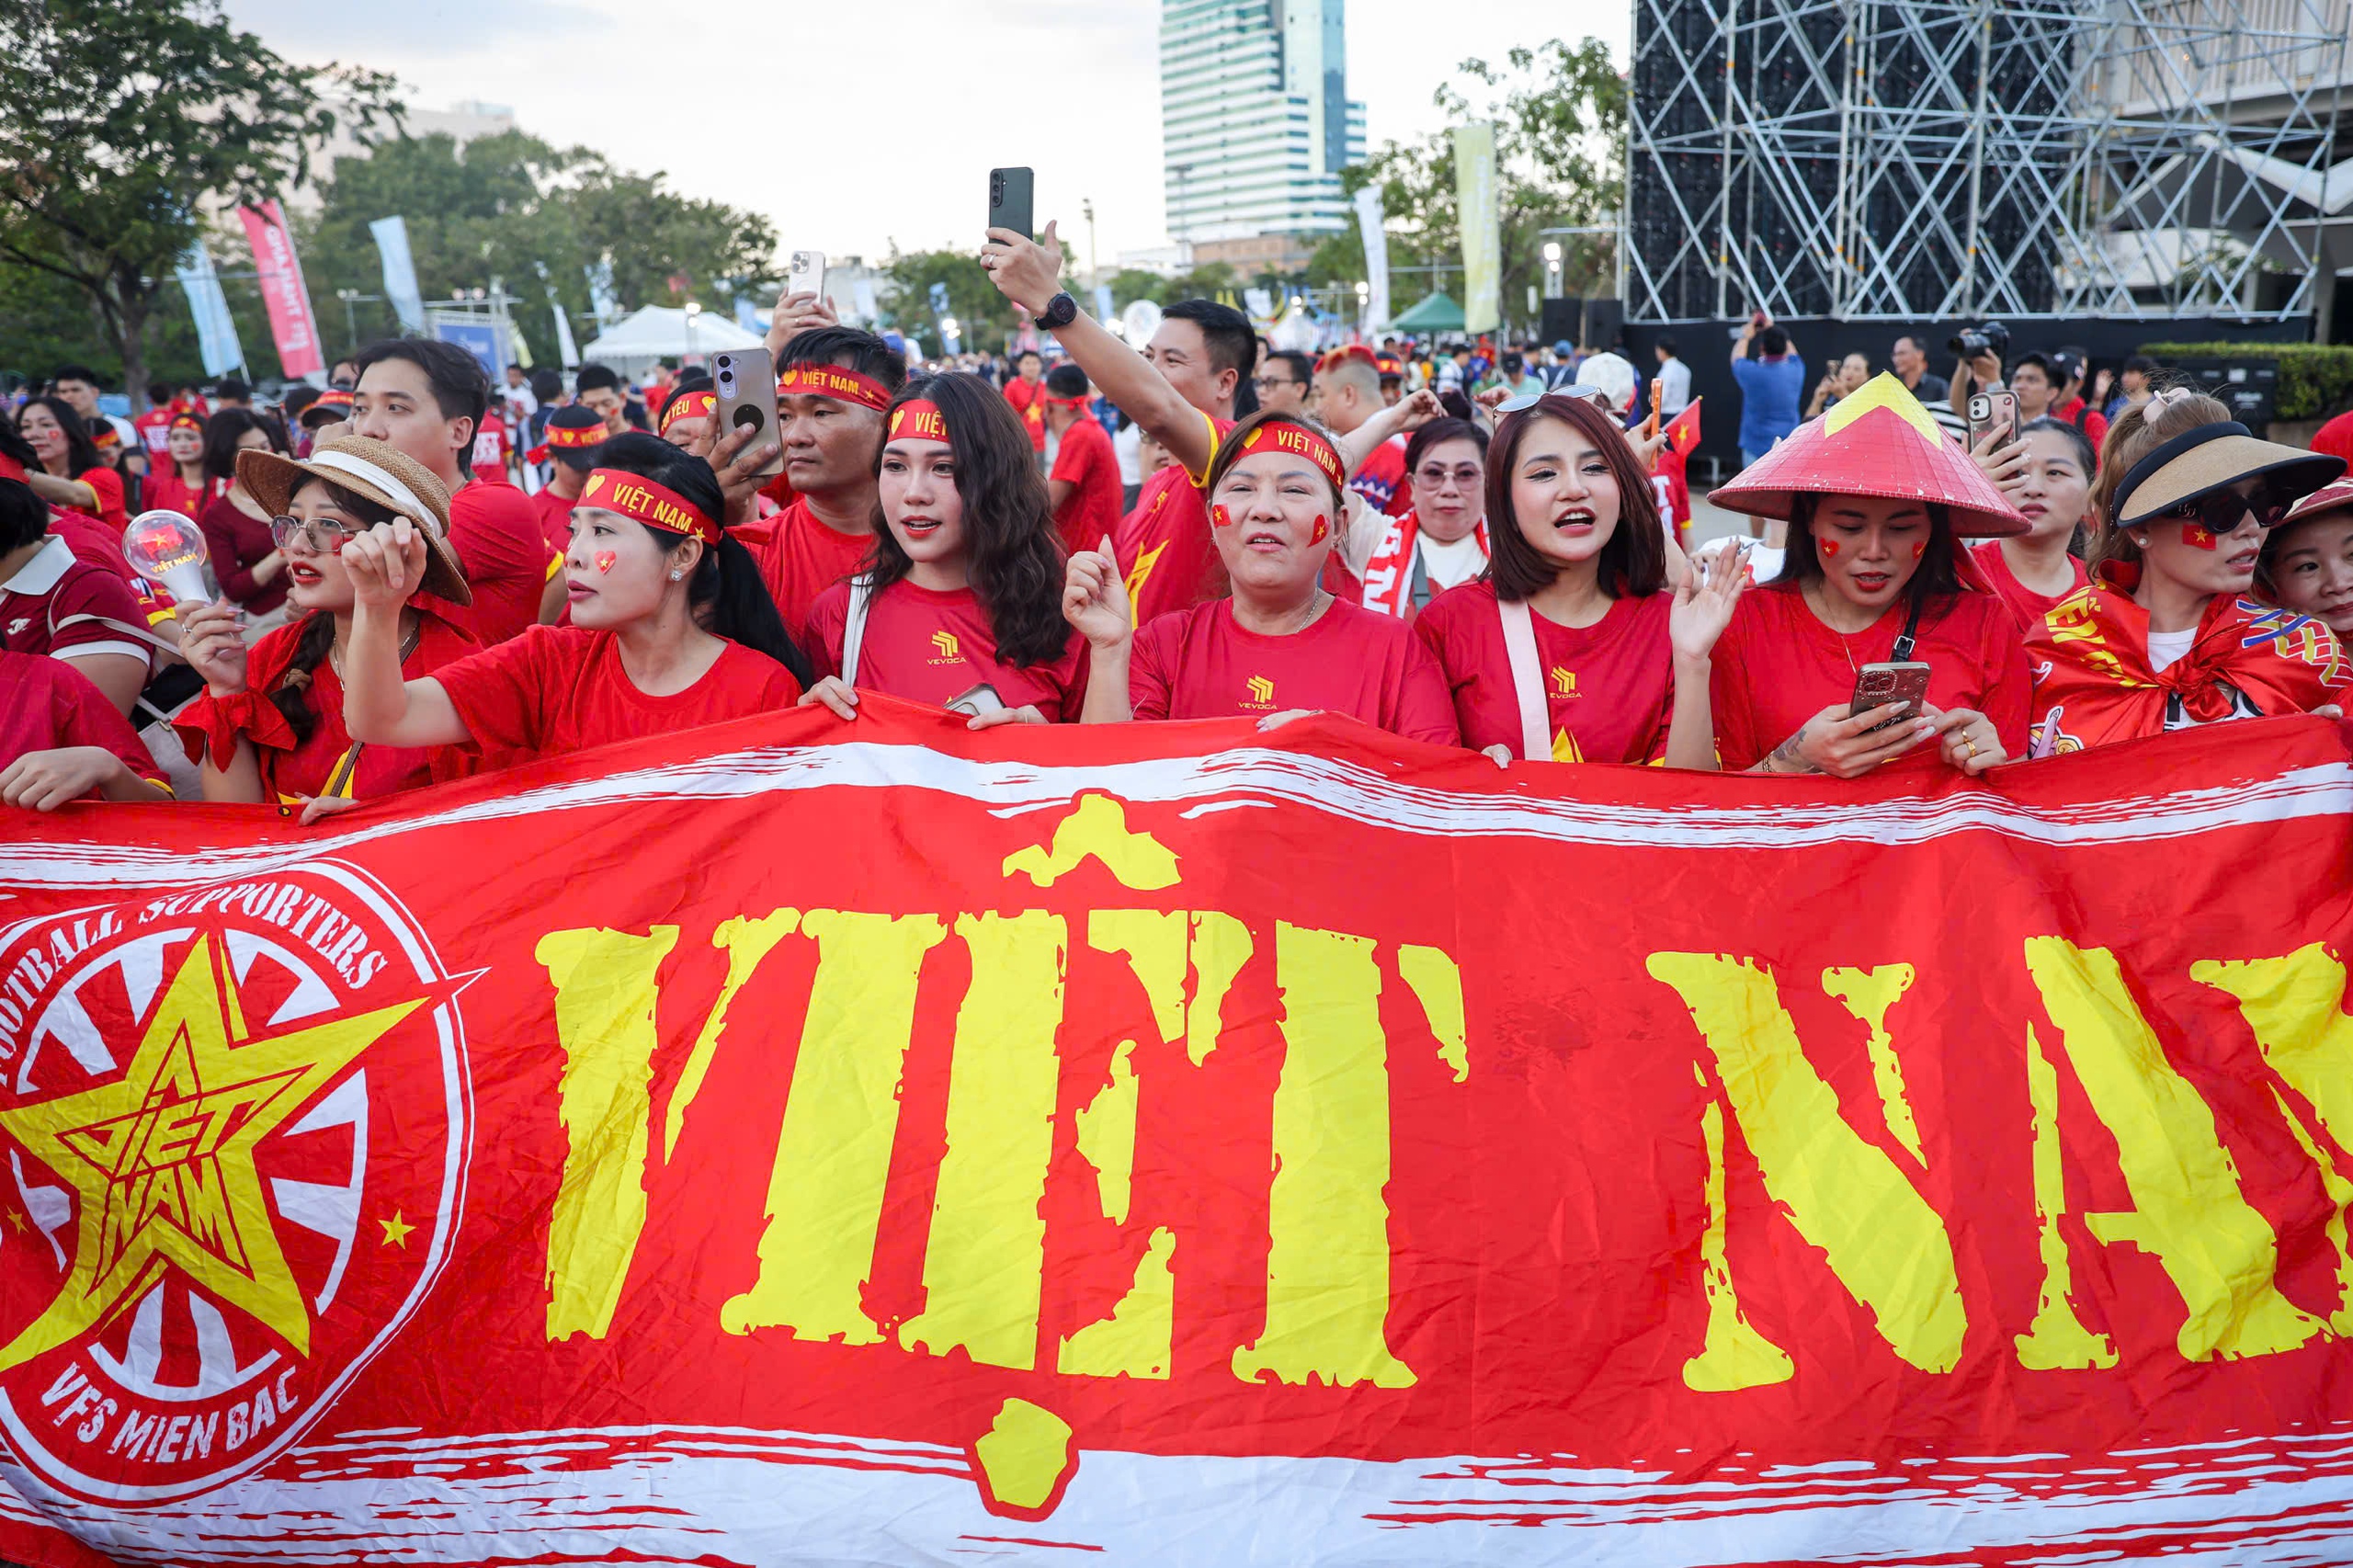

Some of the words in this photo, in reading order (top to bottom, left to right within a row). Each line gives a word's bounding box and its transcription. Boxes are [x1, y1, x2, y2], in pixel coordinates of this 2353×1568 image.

[830, 374, 859, 395] NAM
[1278, 429, 1311, 452] VIỆT
[1313, 444, 1336, 475] NAM
[612, 482, 654, 513] VIỆT
[653, 499, 693, 533] NAM
[926, 656, 967, 665] VEVOCA
[0, 909, 123, 1088] OOTBALL
[138, 882, 388, 989] SUPPORTERS
[535, 793, 1469, 1507] VIỆT
[41, 1361, 118, 1443] VFS
[107, 1409, 220, 1463] MIEN
[226, 1365, 299, 1452] BAC
